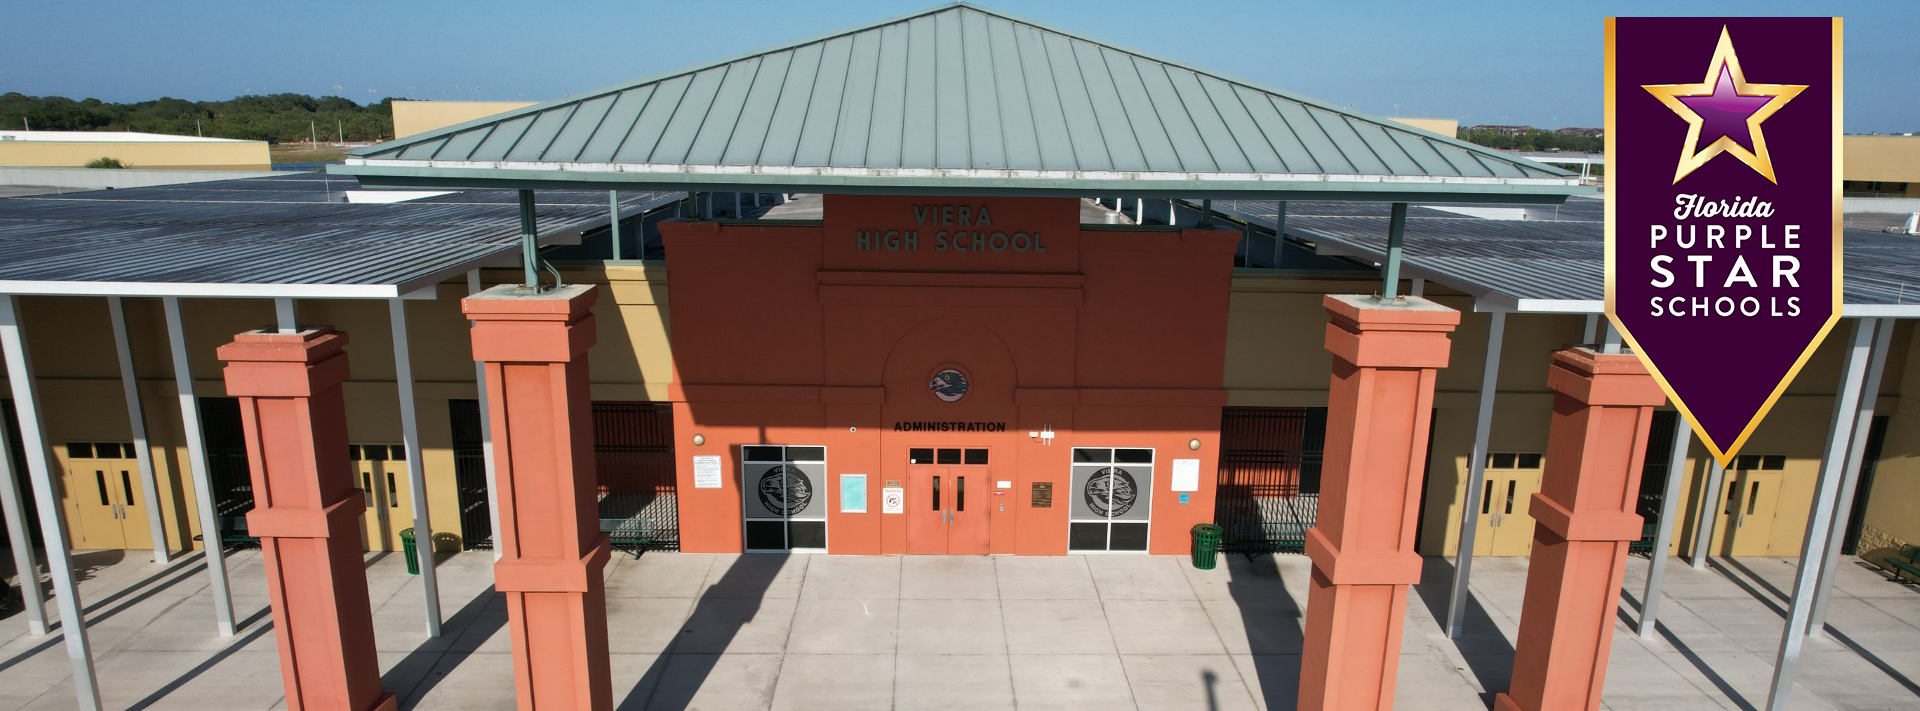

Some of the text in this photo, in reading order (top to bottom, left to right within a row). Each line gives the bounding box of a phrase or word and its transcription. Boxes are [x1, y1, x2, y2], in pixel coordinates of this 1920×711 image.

[912, 204, 993, 227] VIERA
[856, 229, 1046, 253] HIGH SCHOOL
[894, 421, 1006, 432] ADMINISTRATION
